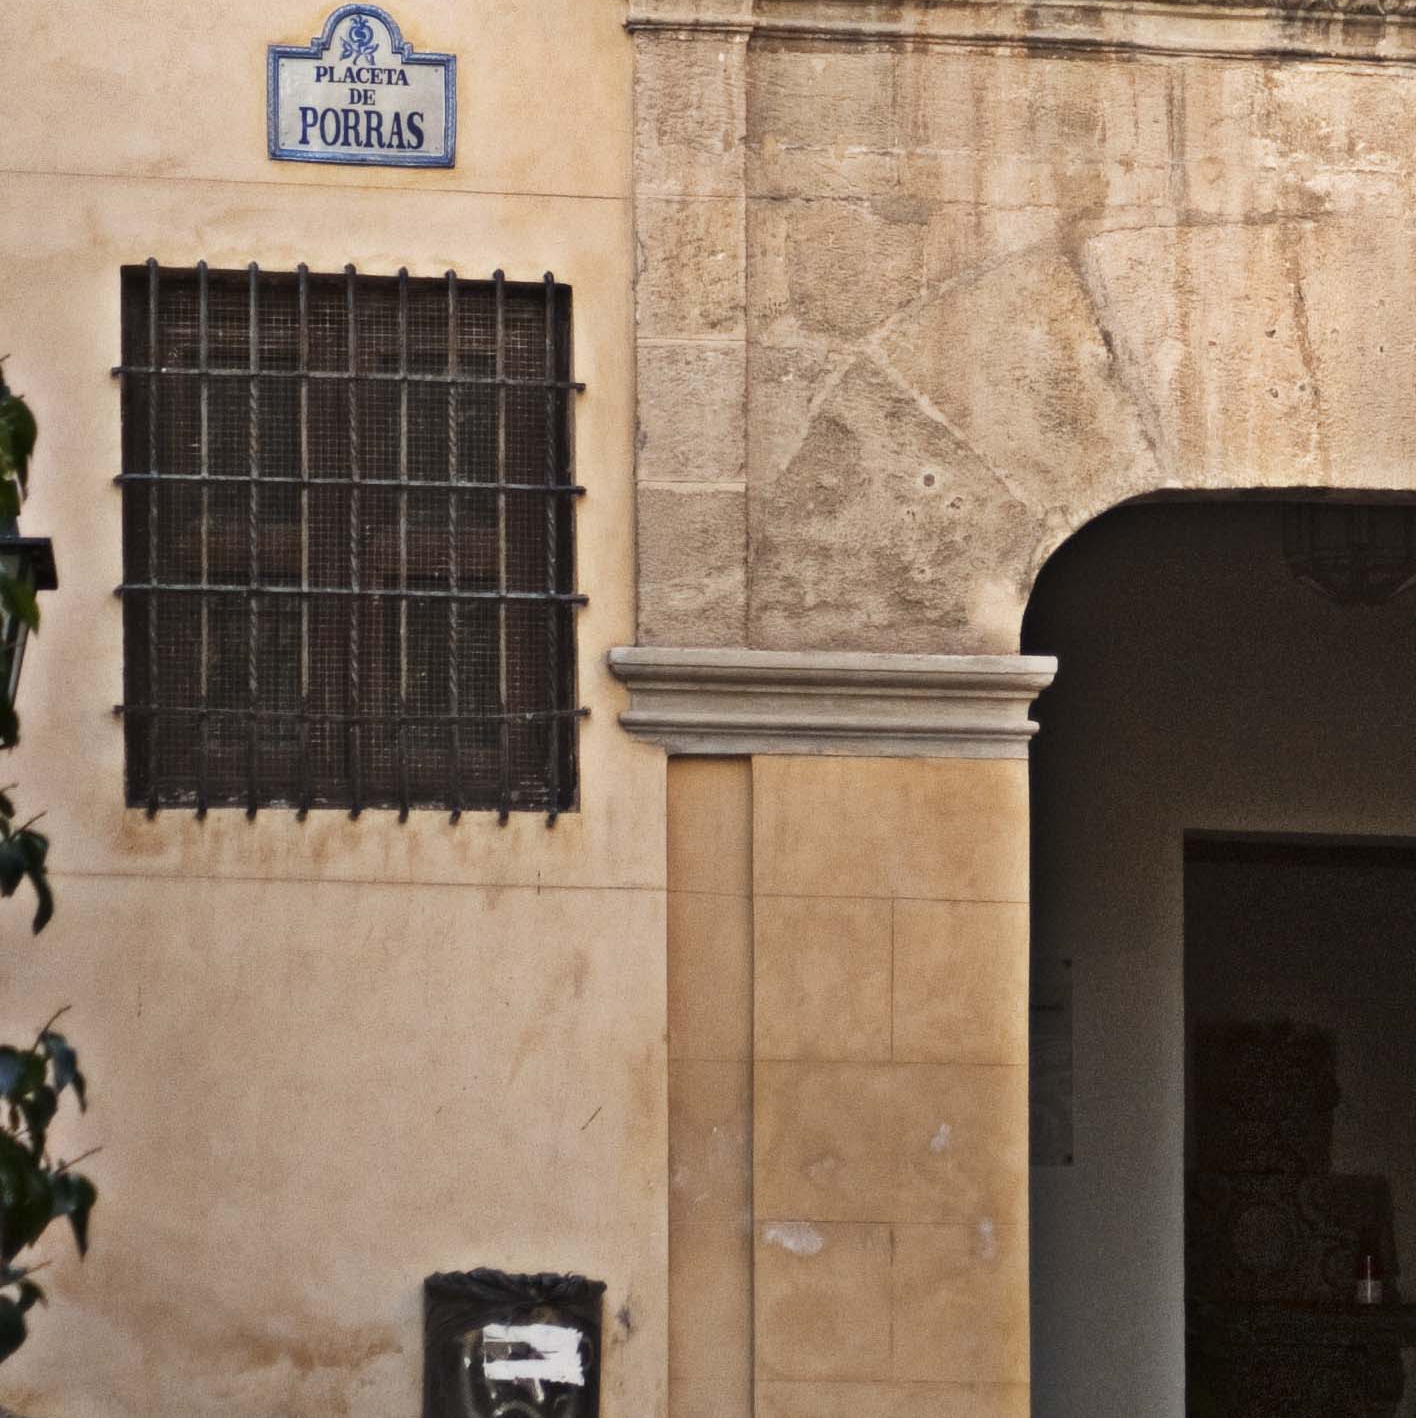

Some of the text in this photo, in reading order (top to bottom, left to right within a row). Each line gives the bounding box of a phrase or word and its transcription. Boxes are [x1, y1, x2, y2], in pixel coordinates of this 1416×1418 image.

[315, 66, 409, 85] PLACETA
[349, 88, 376, 105] DE
[299, 106, 424, 150] PORRAS
